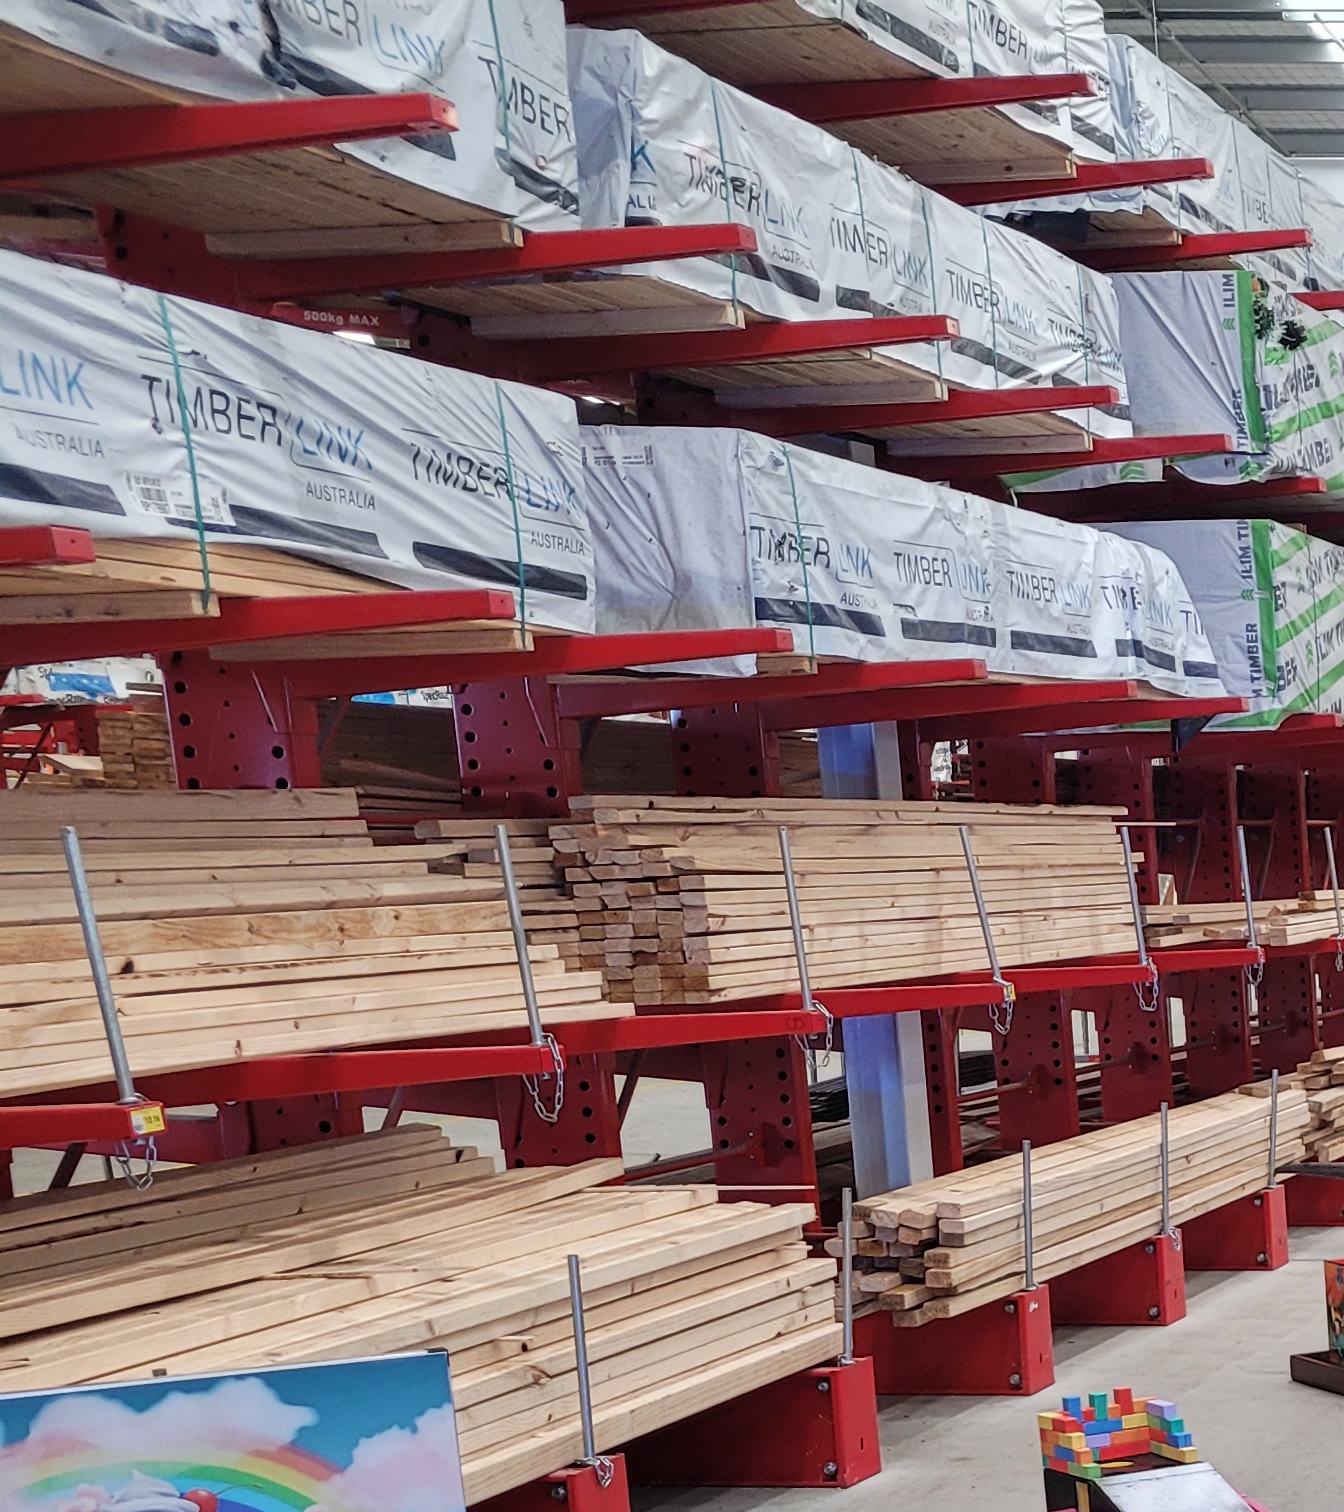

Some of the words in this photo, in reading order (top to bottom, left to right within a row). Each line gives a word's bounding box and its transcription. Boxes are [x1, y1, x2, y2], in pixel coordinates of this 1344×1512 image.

[945, 268, 1001, 322] TIMBER
[304, 310, 345, 326] 500kg
[349, 313, 380, 327] MAX
[294, 413, 374, 470] LINK
[305, 481, 377, 512] AUSTRALIA
[530, 531, 585, 556] AUSTRALIA
[893, 552, 953, 588] TIMBER
[1006, 570, 1058, 603] TIMBER
[1244, 622, 1260, 685] TIMBER
